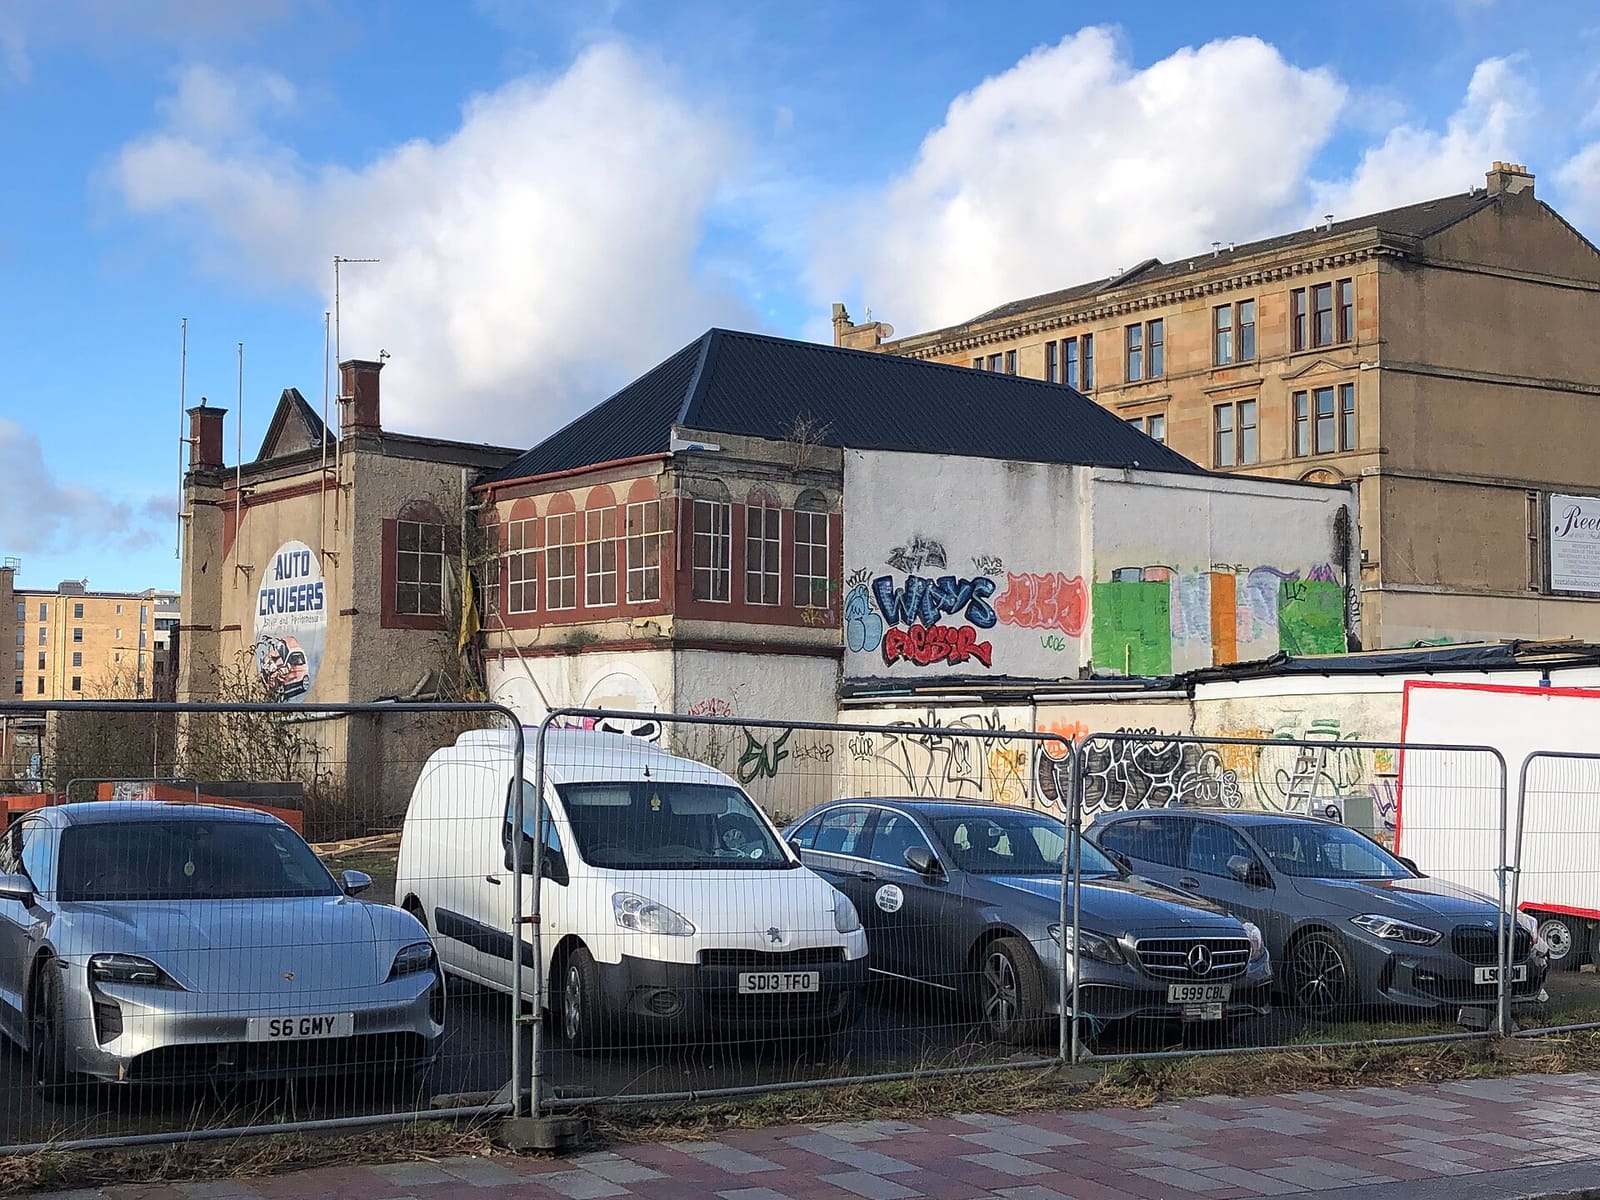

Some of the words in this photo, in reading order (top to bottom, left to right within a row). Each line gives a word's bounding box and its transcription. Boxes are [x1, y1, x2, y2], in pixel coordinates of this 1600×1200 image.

[275, 550, 310, 581] AUTO
[259, 582, 324, 617] CRUISERS
[872, 575, 997, 629] WAYS
[748, 974, 780, 990] SD13
[784, 973, 811, 989] TFO
[1173, 986, 1204, 1001] L999
[1205, 985, 1225, 1000] CBL
[270, 1019, 294, 1037] S6
[300, 1016, 336, 1036] GMY
